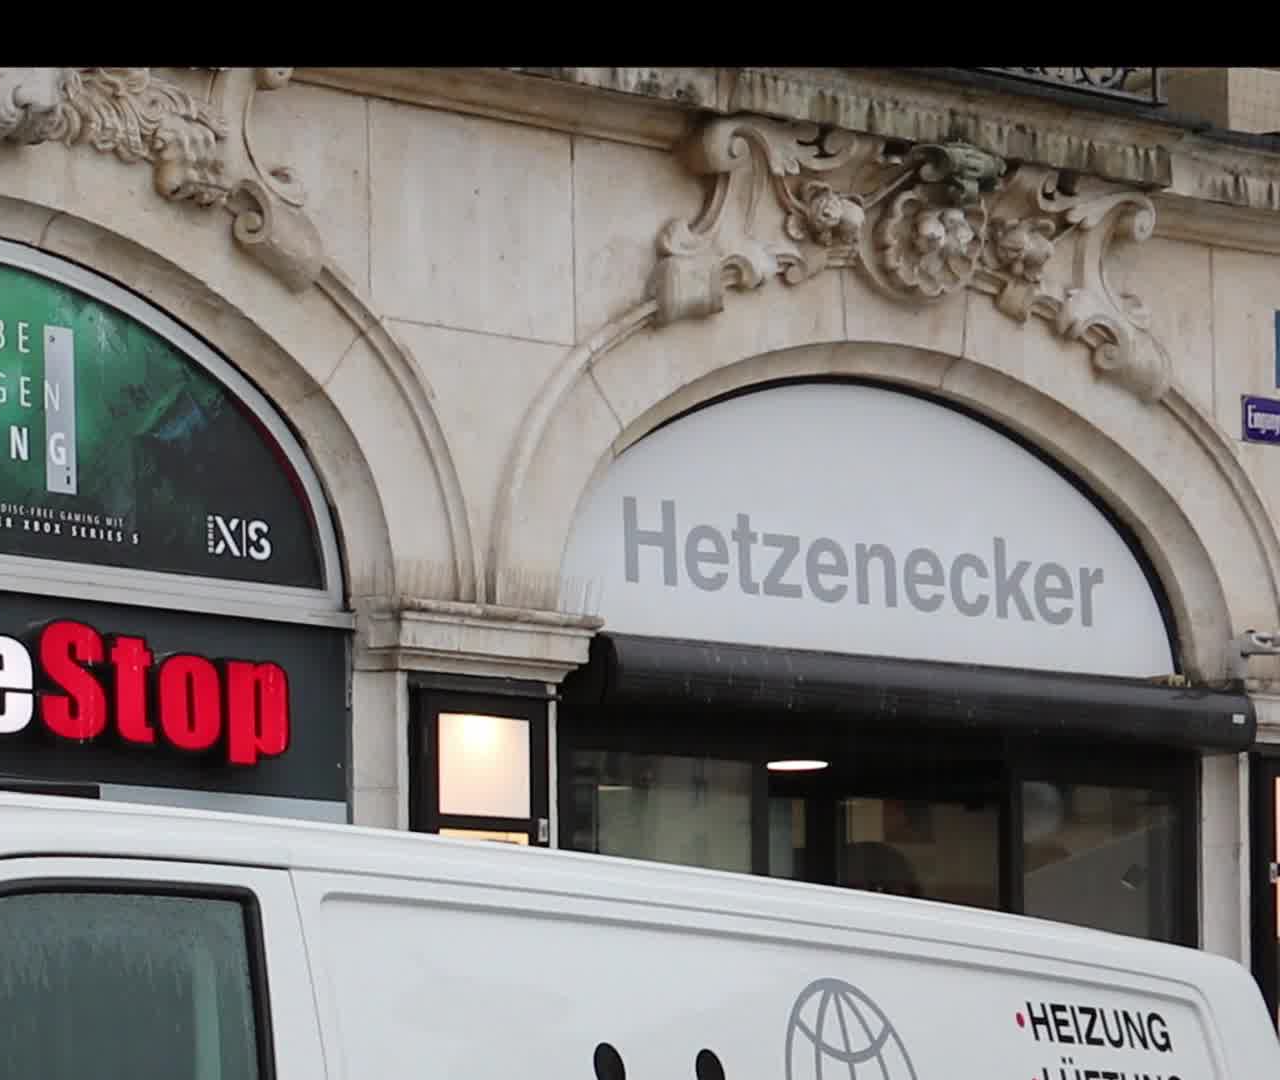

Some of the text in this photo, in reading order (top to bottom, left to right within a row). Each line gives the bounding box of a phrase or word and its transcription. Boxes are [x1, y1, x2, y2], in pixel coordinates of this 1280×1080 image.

[23, 519, 61, 534] XBOX
[72, 525, 122, 542] SERIES
[60, 511, 100, 525] GAMING
[622, 496, 1104, 627] Hetzenecker
[1026, 1001, 1172, 1053] HEIZUNG
